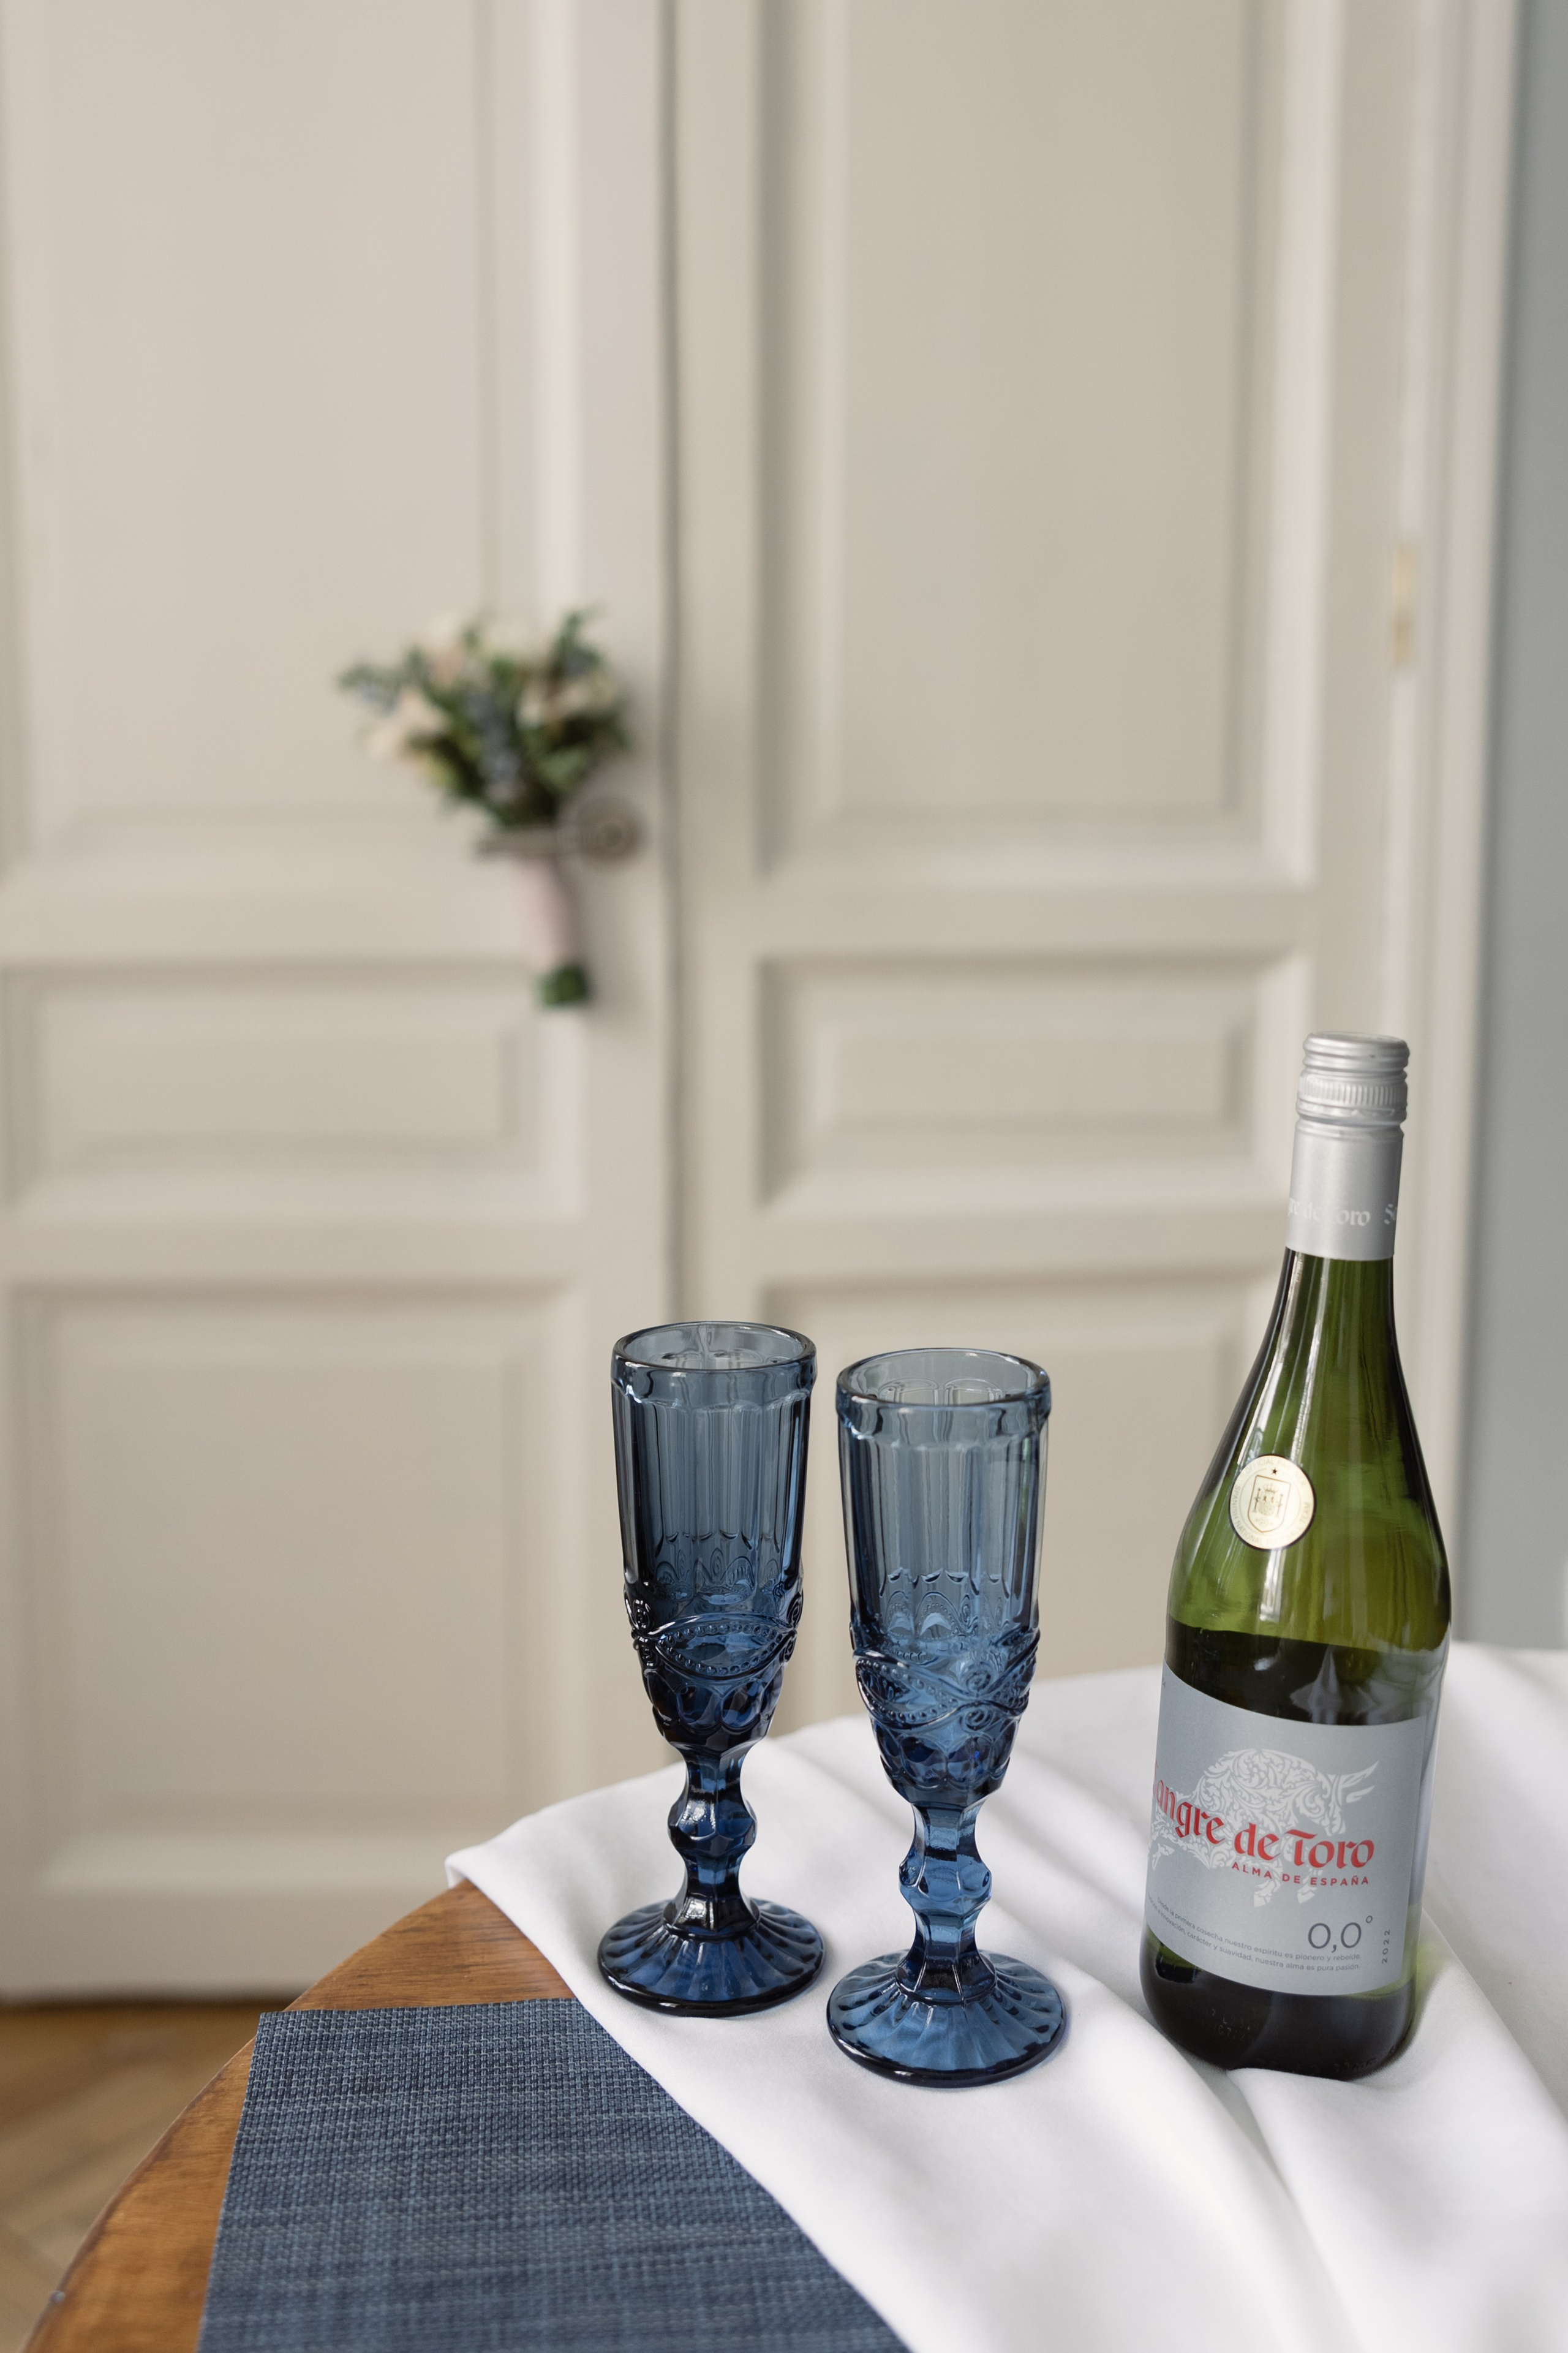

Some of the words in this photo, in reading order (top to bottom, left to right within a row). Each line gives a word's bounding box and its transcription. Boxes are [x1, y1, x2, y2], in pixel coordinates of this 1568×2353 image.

[1234, 1822, 1281, 1861] de
[1284, 1829, 1374, 1869] Toro
[1232, 1861, 1273, 1879] ALMA
[1281, 1873, 1301, 1884] DE
[1310, 1875, 1369, 1887] ESPAÑA
[1170, 1907, 1175, 1916] la
[1175, 1913, 1196, 1930] primera
[1196, 1926, 1223, 1942] cosecha
[1224, 1937, 1252, 1951] nuestro
[1253, 1946, 1283, 1957] espíritu
[1295, 1952, 1325, 1961] pionero
[1186, 1930, 1212, 1947] carácter
[1219, 1945, 1253, 1962] suavidad,
[1254, 1957, 1284, 1968] nuestra
[1285, 1962, 1304, 1971] alma
[1381, 1928, 1391, 1965] 2022
